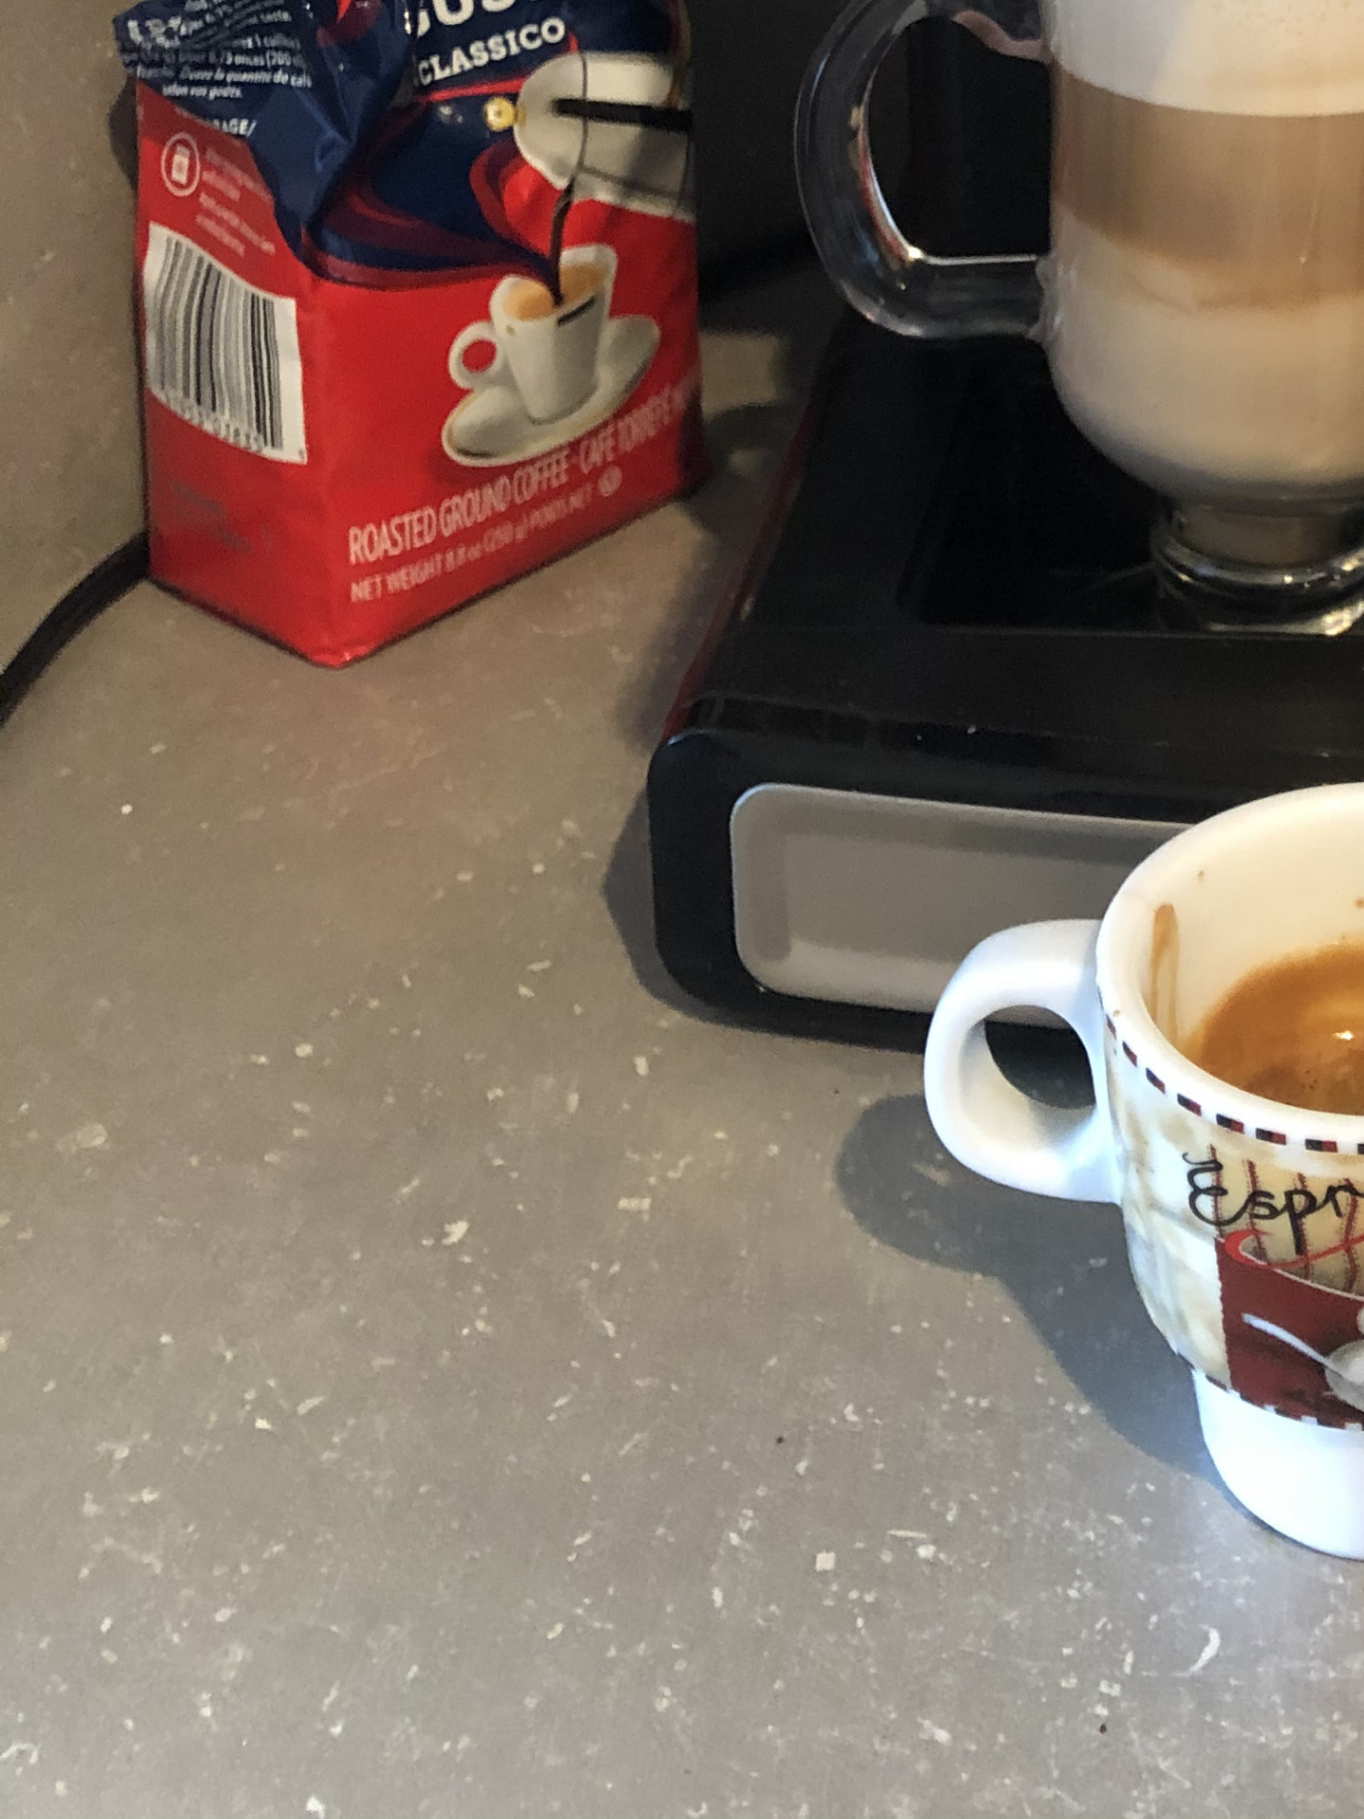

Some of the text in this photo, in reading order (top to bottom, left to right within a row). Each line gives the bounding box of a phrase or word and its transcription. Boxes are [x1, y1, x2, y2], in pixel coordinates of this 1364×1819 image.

[418, 16, 566, 86] CLASSICO
[348, 504, 438, 565] ROASTED
[438, 474, 513, 537] GROUND
[513, 445, 571, 505] COFFEE
[350, 573, 384, 602] NET
[385, 551, 443, 594] WEIGHT
